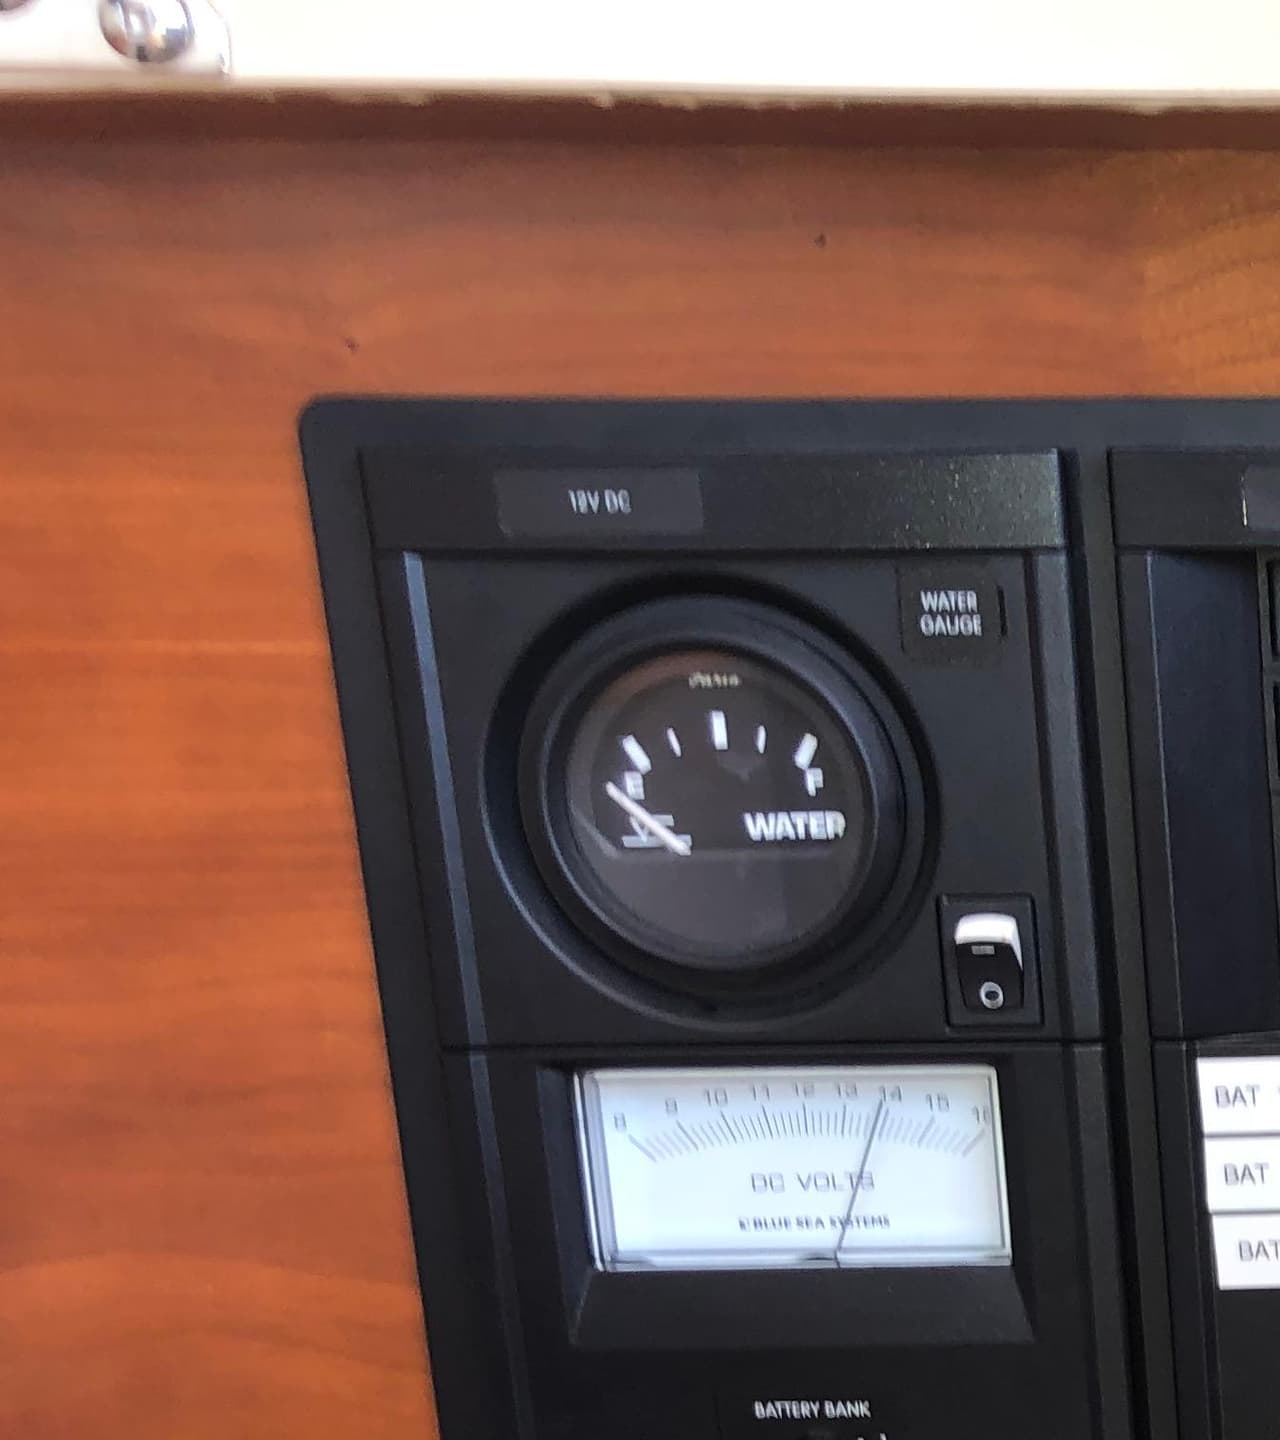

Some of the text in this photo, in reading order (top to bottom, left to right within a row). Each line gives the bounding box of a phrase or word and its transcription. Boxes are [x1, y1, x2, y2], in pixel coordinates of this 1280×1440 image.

[919, 590, 978, 614] WATER
[919, 613, 983, 637] GAUGE
[744, 811, 845, 840] WATER
[705, 1088, 728, 1106] 10
[1215, 1084, 1260, 1108] BAT
[751, 1172, 874, 1193] DC VOLTS
[1224, 1162, 1269, 1186] BAT
[754, 1215, 890, 1231] BLUE SEA SYSTEMS
[754, 1400, 872, 1419] BATTERY BANK
